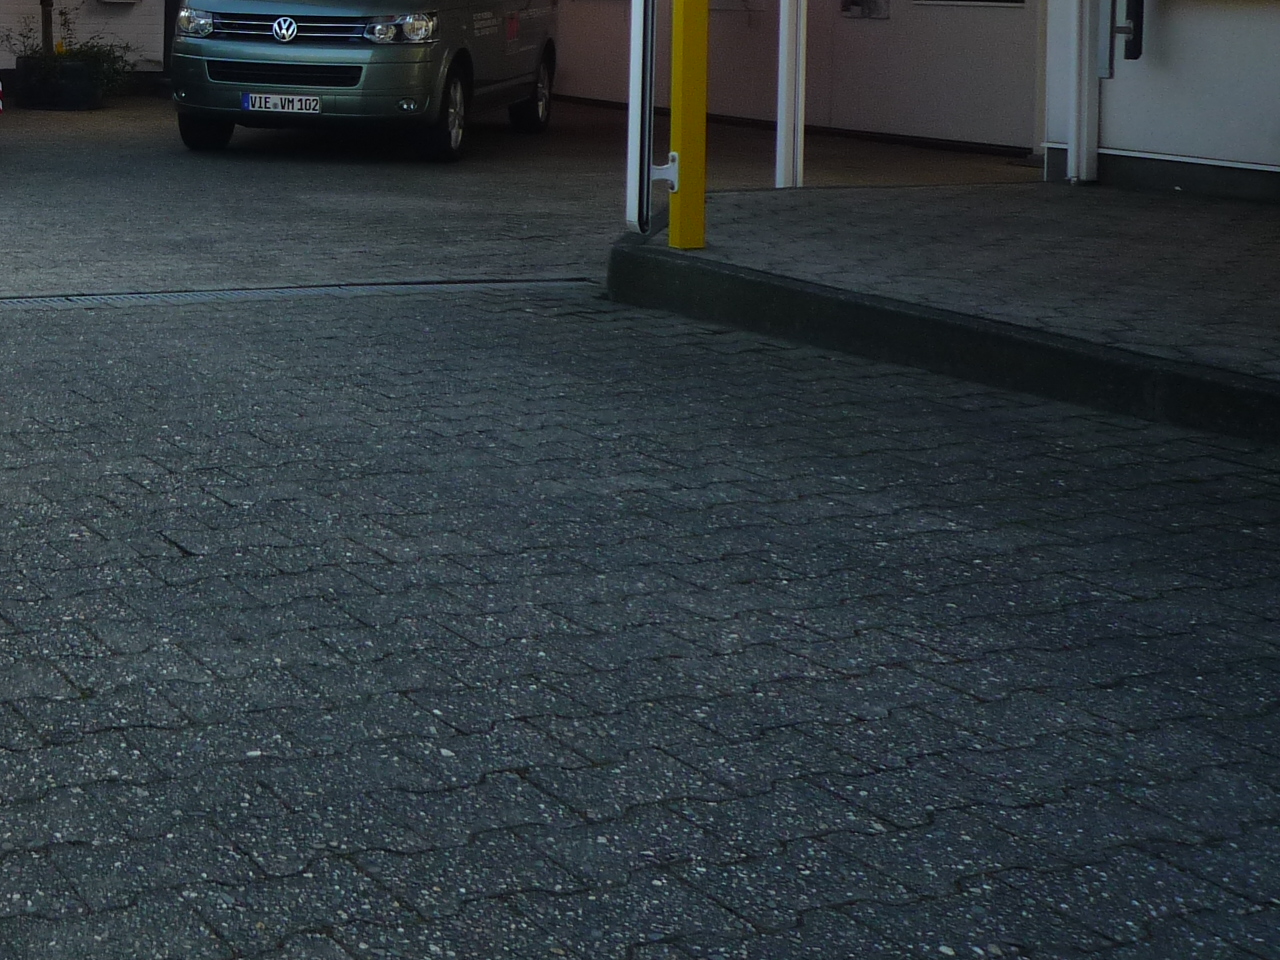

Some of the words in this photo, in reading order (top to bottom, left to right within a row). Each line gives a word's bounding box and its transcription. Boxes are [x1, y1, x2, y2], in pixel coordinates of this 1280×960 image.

[250, 96, 271, 110] VIE
[280, 97, 295, 111] VM
[297, 98, 319, 112] 102
